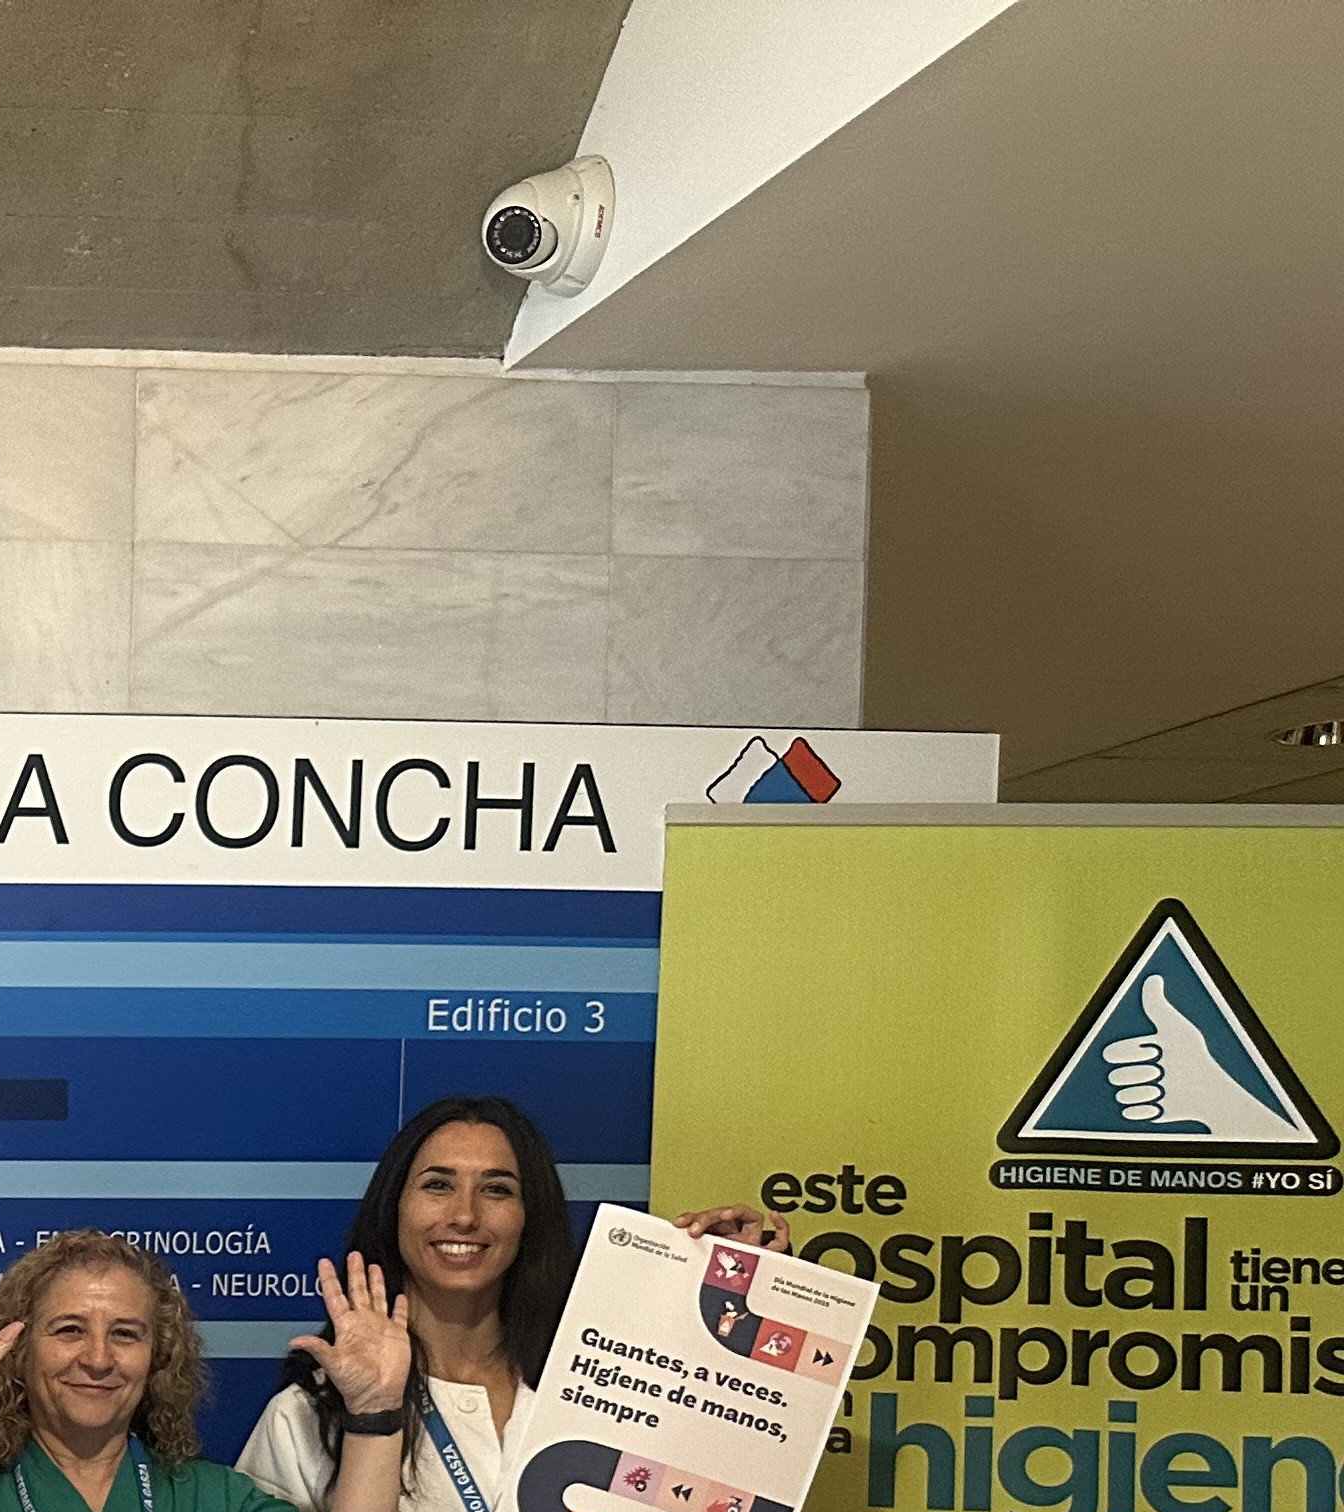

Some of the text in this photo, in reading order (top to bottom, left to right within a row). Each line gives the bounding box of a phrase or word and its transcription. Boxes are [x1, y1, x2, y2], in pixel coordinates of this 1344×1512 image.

[109, 752, 616, 855] CONCHA
[426, 999, 605, 1033] Edificio 3
[761, 1165, 907, 1213] este
[1000, 1166, 1332, 1189] HIGIENE DE MANOS #YO SÍ
[761, 1213, 1208, 1322] ospital
[1230, 1249, 1344, 1286] tiene
[1231, 1284, 1289, 1311] un
[581, 1327, 788, 1408] Guantes, veces.
[852, 1317, 1344, 1399] ompromis
[560, 1385, 660, 1429] siempre
[570, 1354, 788, 1443] Higiene manos,
